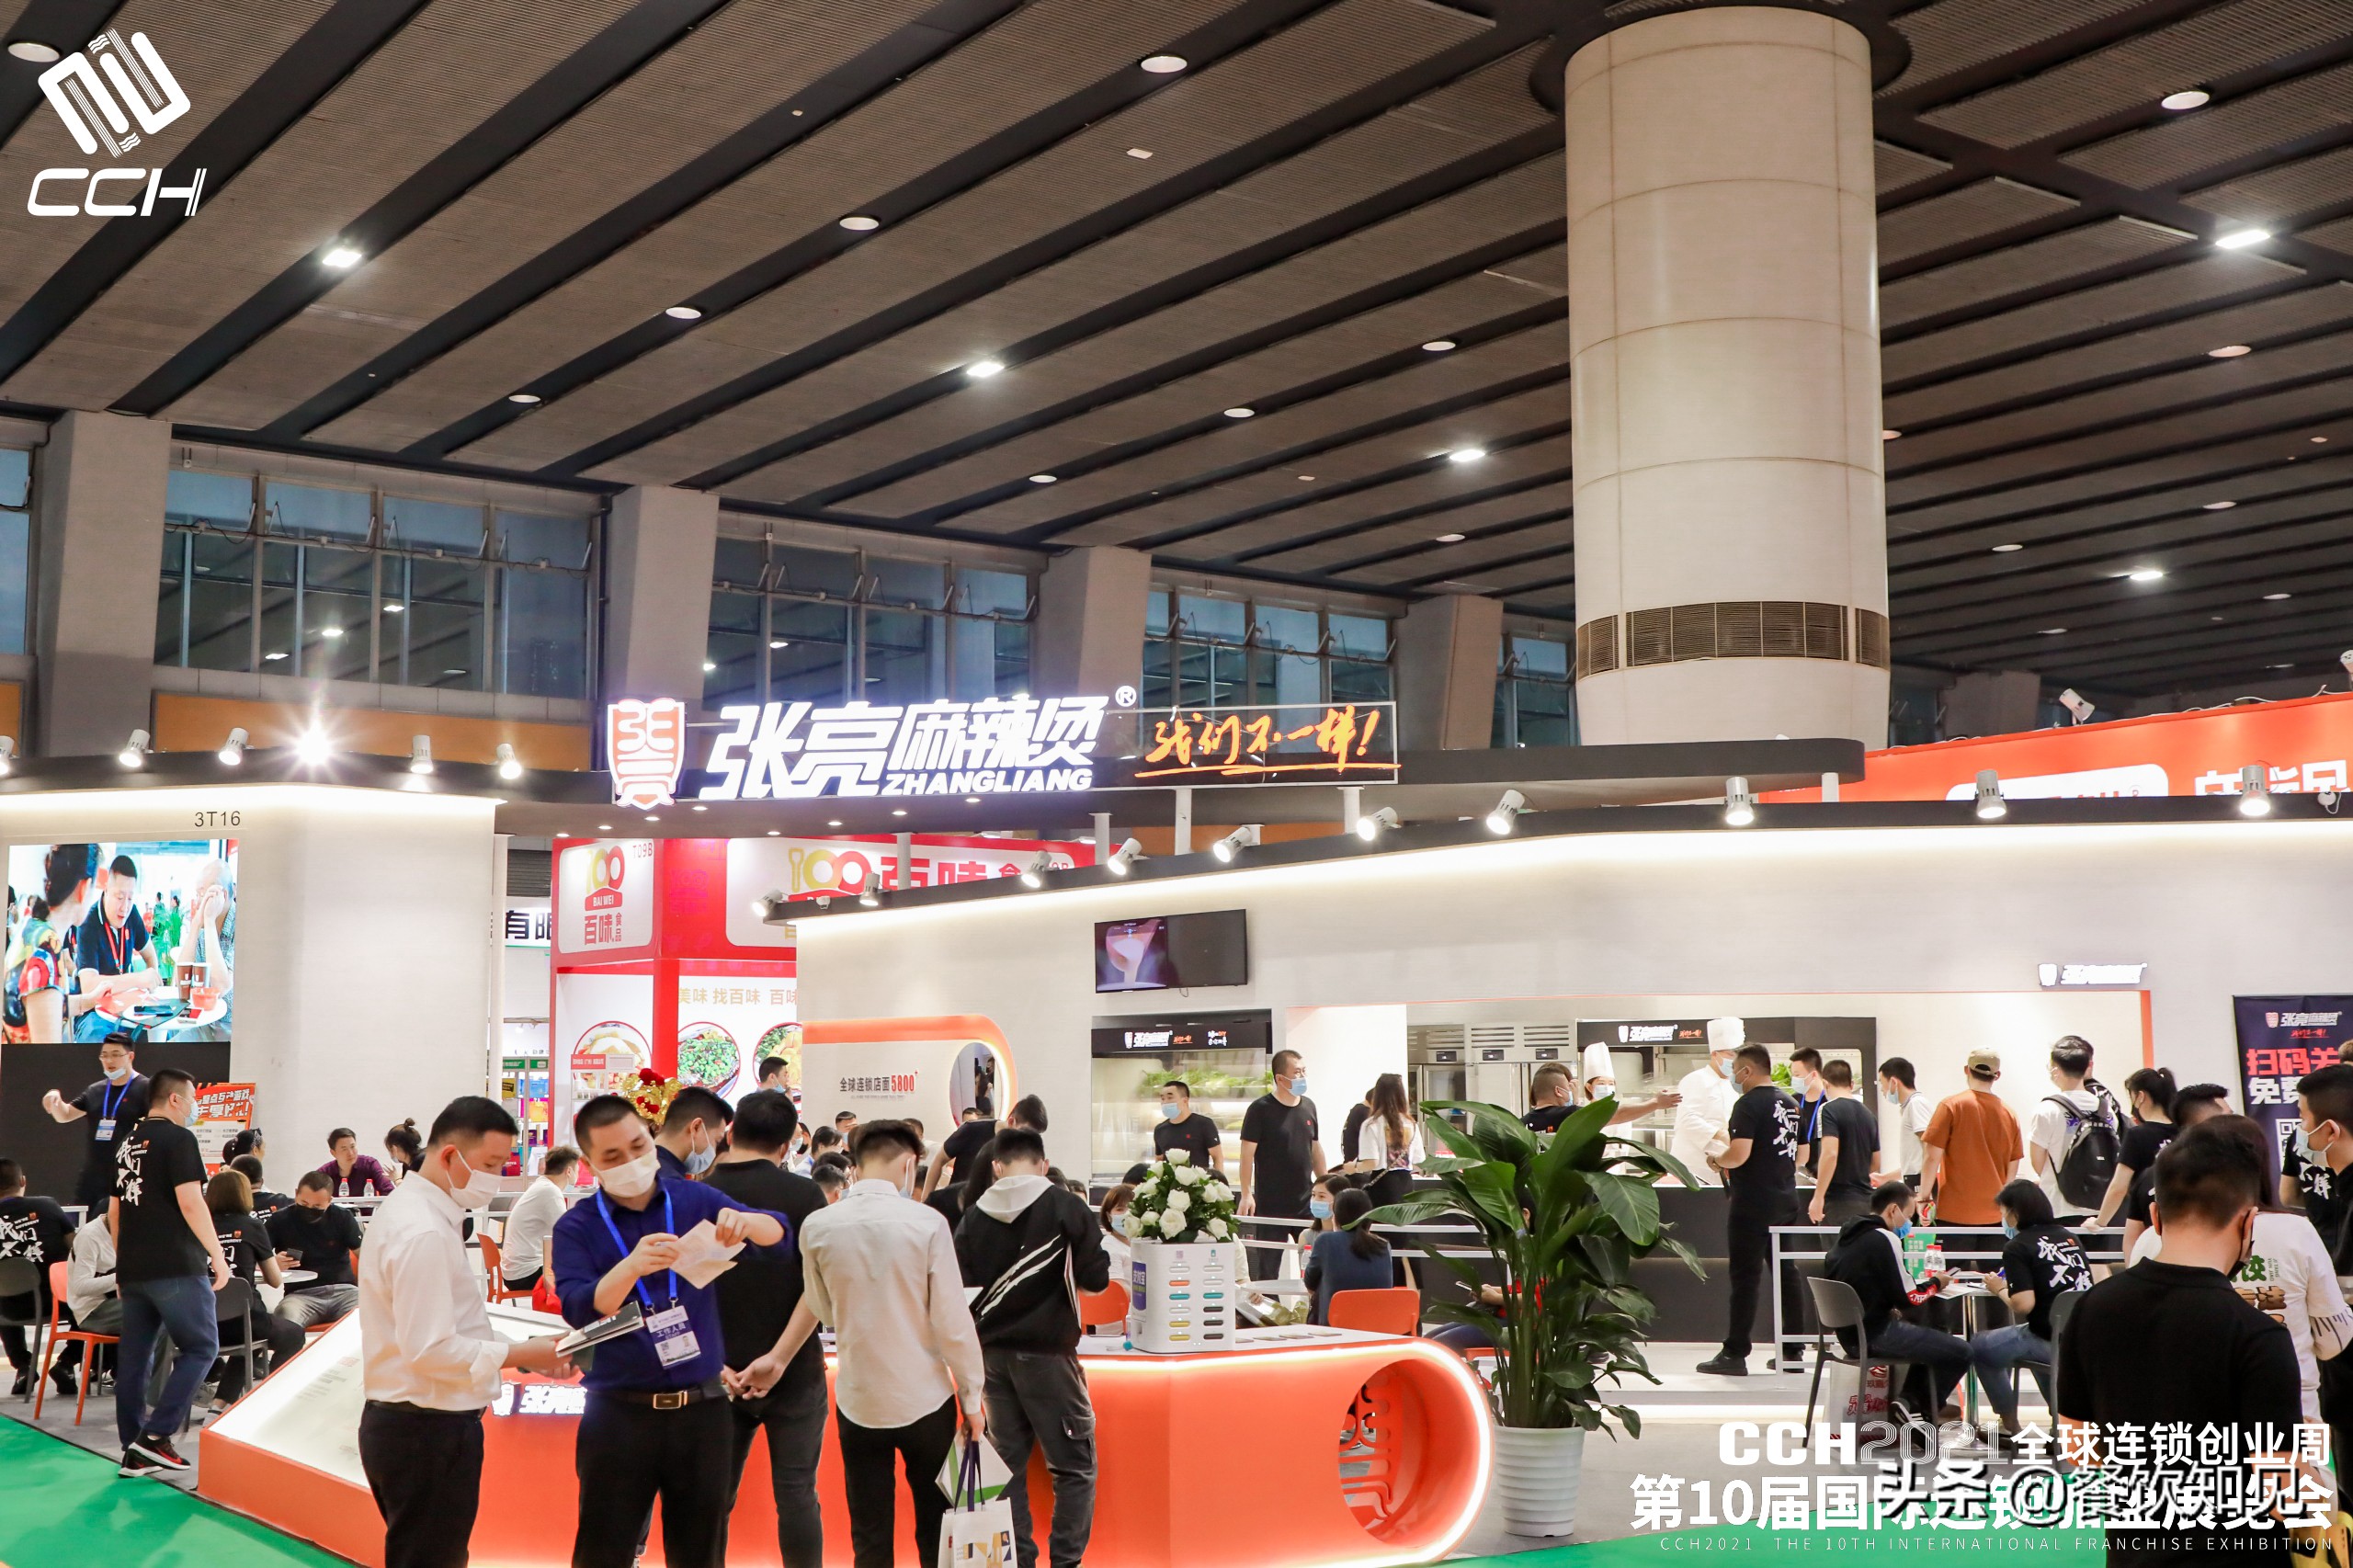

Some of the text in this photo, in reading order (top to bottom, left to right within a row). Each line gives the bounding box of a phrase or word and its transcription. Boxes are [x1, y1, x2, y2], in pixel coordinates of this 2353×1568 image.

[699, 693, 1109, 801] 张亮麻辣烫
[881, 768, 1094, 796] ZHANGLIANG
[194, 811, 241, 827] 3T16
